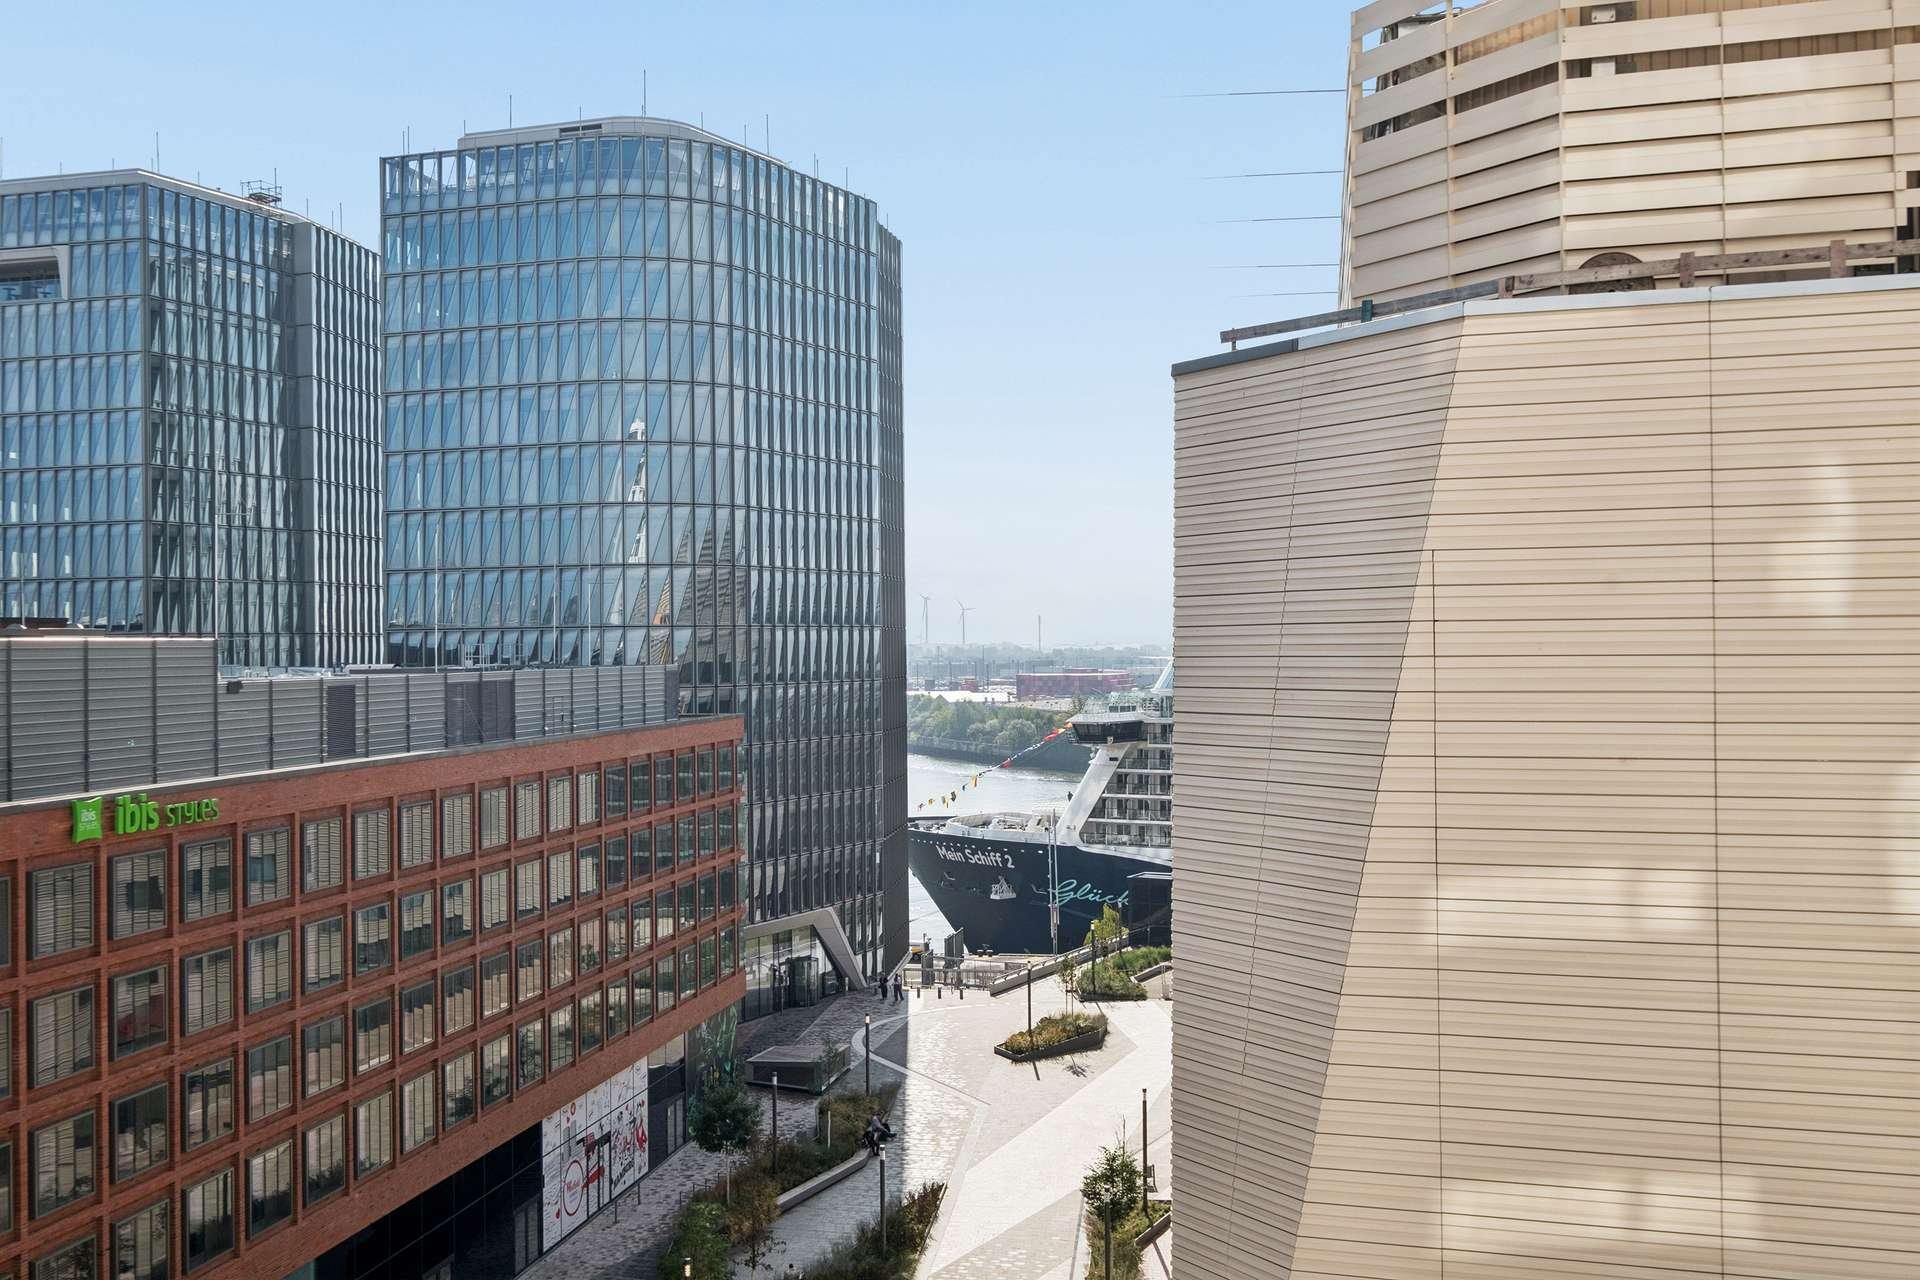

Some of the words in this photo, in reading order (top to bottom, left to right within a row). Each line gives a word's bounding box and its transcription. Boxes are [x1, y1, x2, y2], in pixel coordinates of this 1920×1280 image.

[114, 793, 160, 835] ibis
[935, 845, 965, 863] Mein
[965, 849, 1002, 868] Schiff
[1004, 854, 1016, 869] 2
